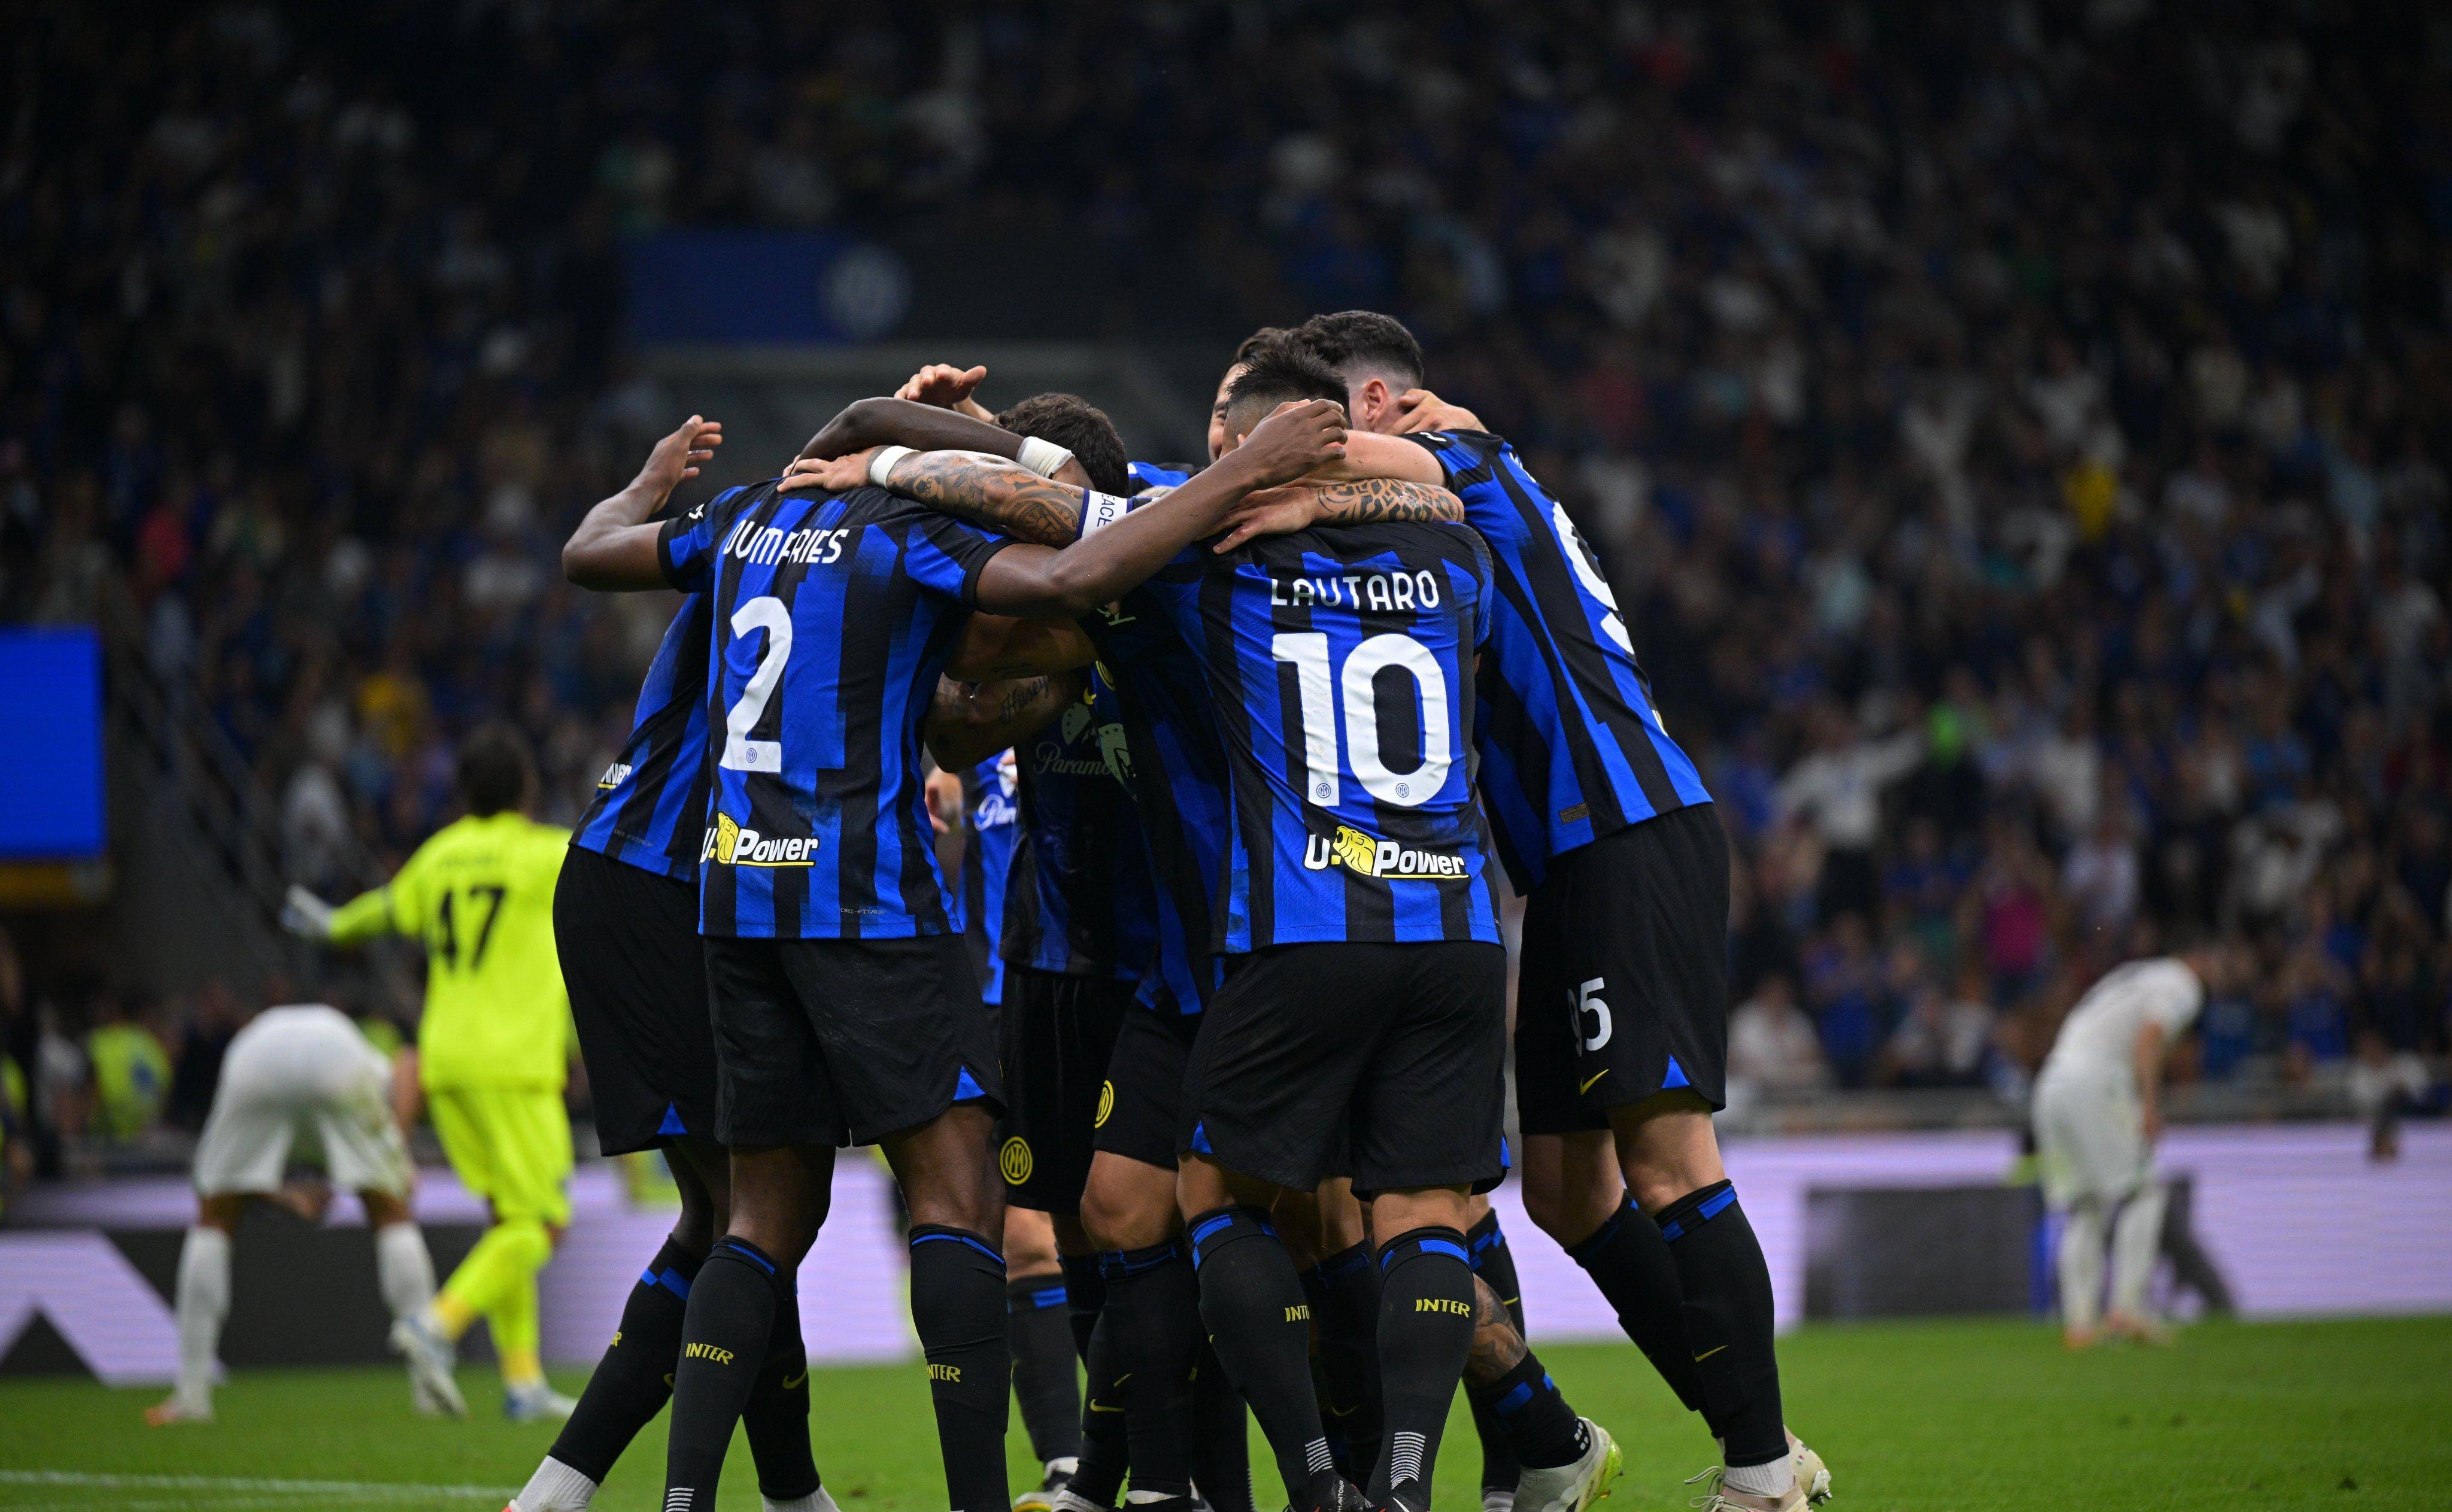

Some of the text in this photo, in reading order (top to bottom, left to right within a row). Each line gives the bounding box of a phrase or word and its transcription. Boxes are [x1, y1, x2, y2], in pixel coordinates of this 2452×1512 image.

[723, 520, 849, 565] DUMFRIES
[1271, 570, 1438, 611] LAUTARO
[718, 596, 793, 773] 2
[1271, 632, 1452, 807] 10
[730, 829, 819, 864] Power
[1372, 841, 1465, 878] Power
[1415, 1298, 1470, 1317] INTER
[685, 1343, 734, 1365] INTER
